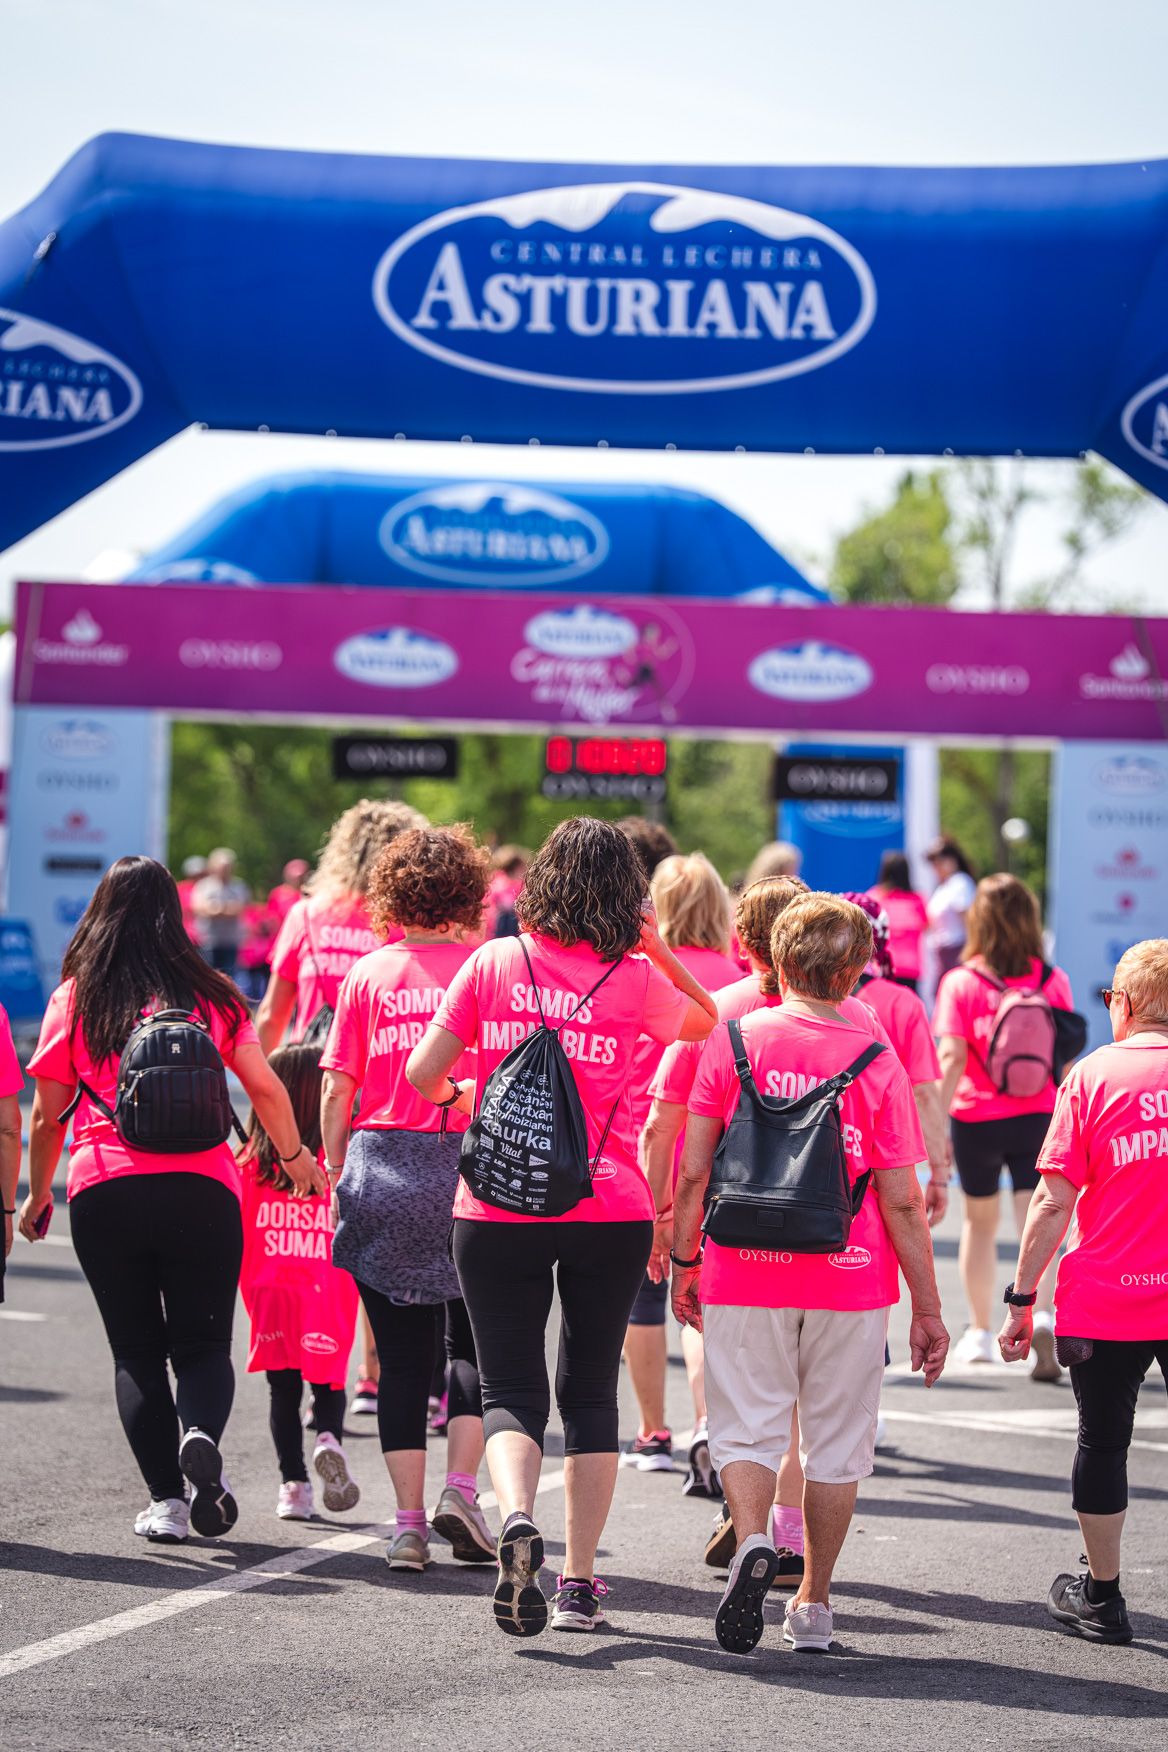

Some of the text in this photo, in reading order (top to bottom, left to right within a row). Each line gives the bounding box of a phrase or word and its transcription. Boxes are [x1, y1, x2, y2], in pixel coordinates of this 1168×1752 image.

[491, 241, 822, 270] CENTRAL LECHERA
[411, 242, 837, 341] ASTURIANA
[787, 763, 889, 796] OYSHO
[511, 982, 593, 1024] SOMOS
[481, 1075, 517, 1133] ARABA
[501, 1098, 553, 1121] martxan
[496, 1109, 553, 1133] minbiziaren
[491, 1122, 552, 1151] aurka
[500, 1142, 523, 1158] Vital
[264, 1230, 327, 1261] SUMA
[739, 1248, 793, 1264] OYSHO
